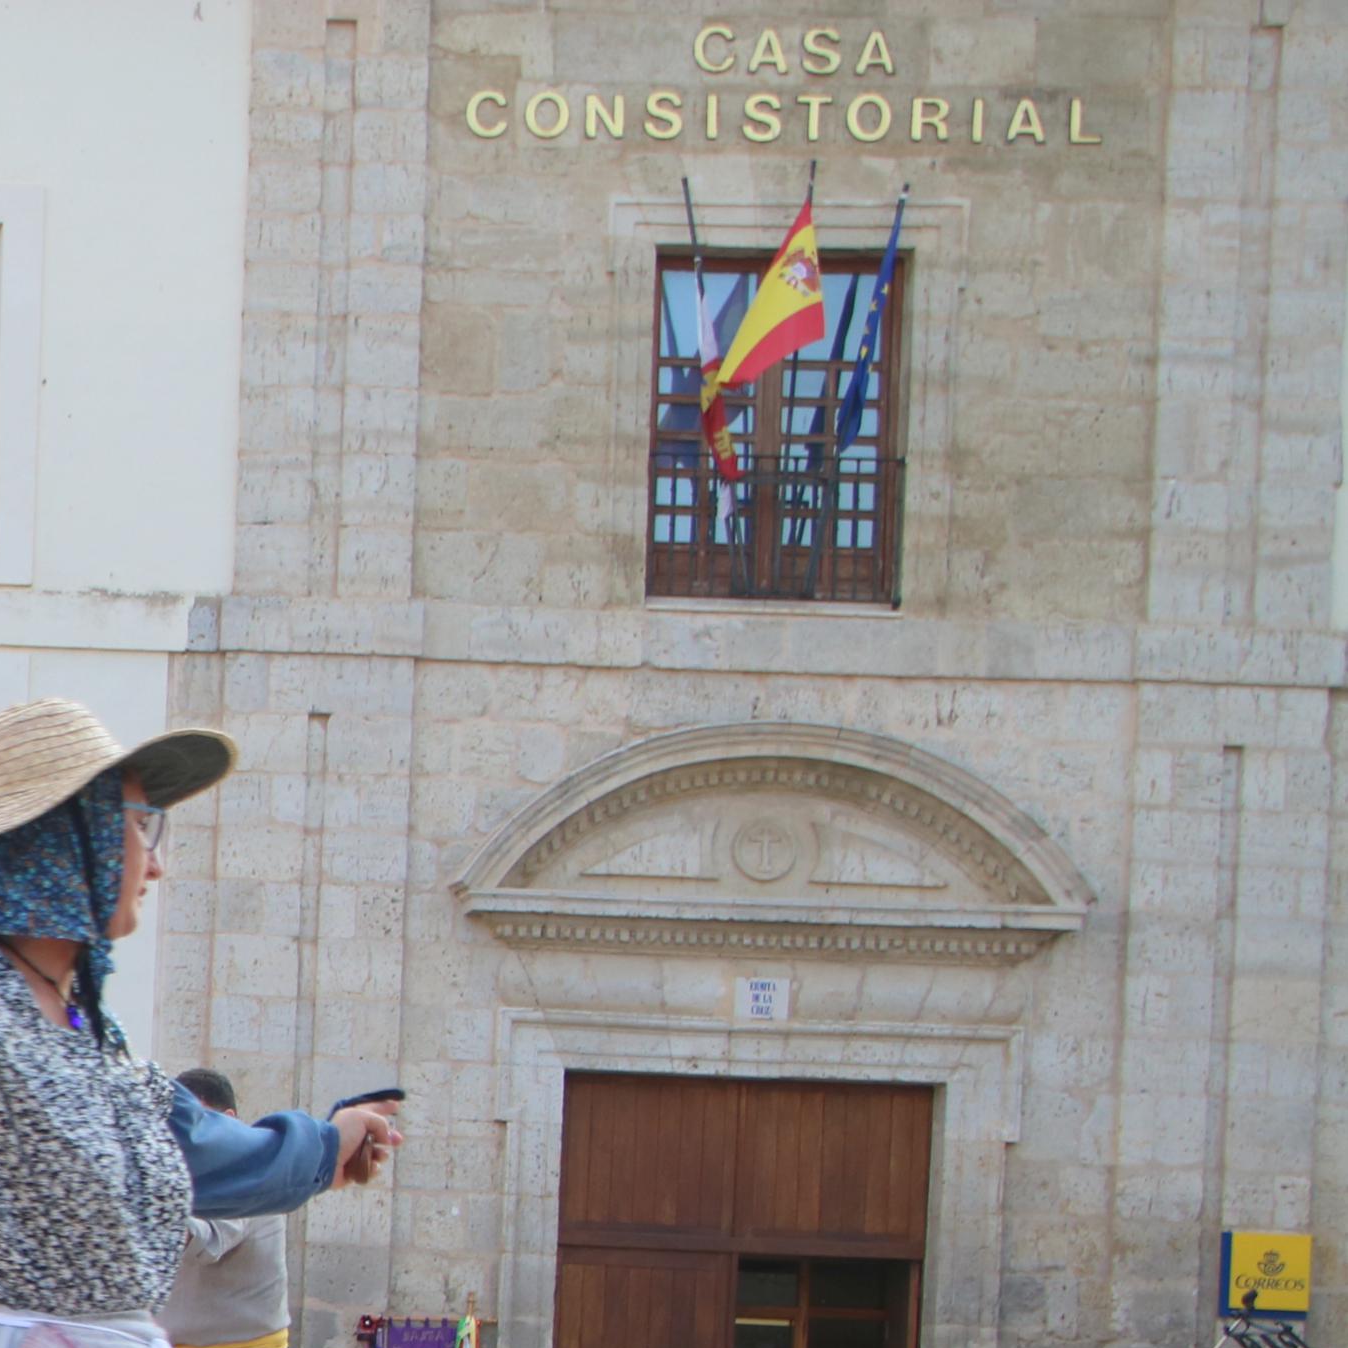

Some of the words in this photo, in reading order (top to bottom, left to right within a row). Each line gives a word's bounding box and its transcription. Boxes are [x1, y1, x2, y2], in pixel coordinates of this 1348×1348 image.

[693, 25, 896, 76] CASA
[465, 90, 1103, 145] CONSISTORIAL
[762, 993, 773, 1004] LA
